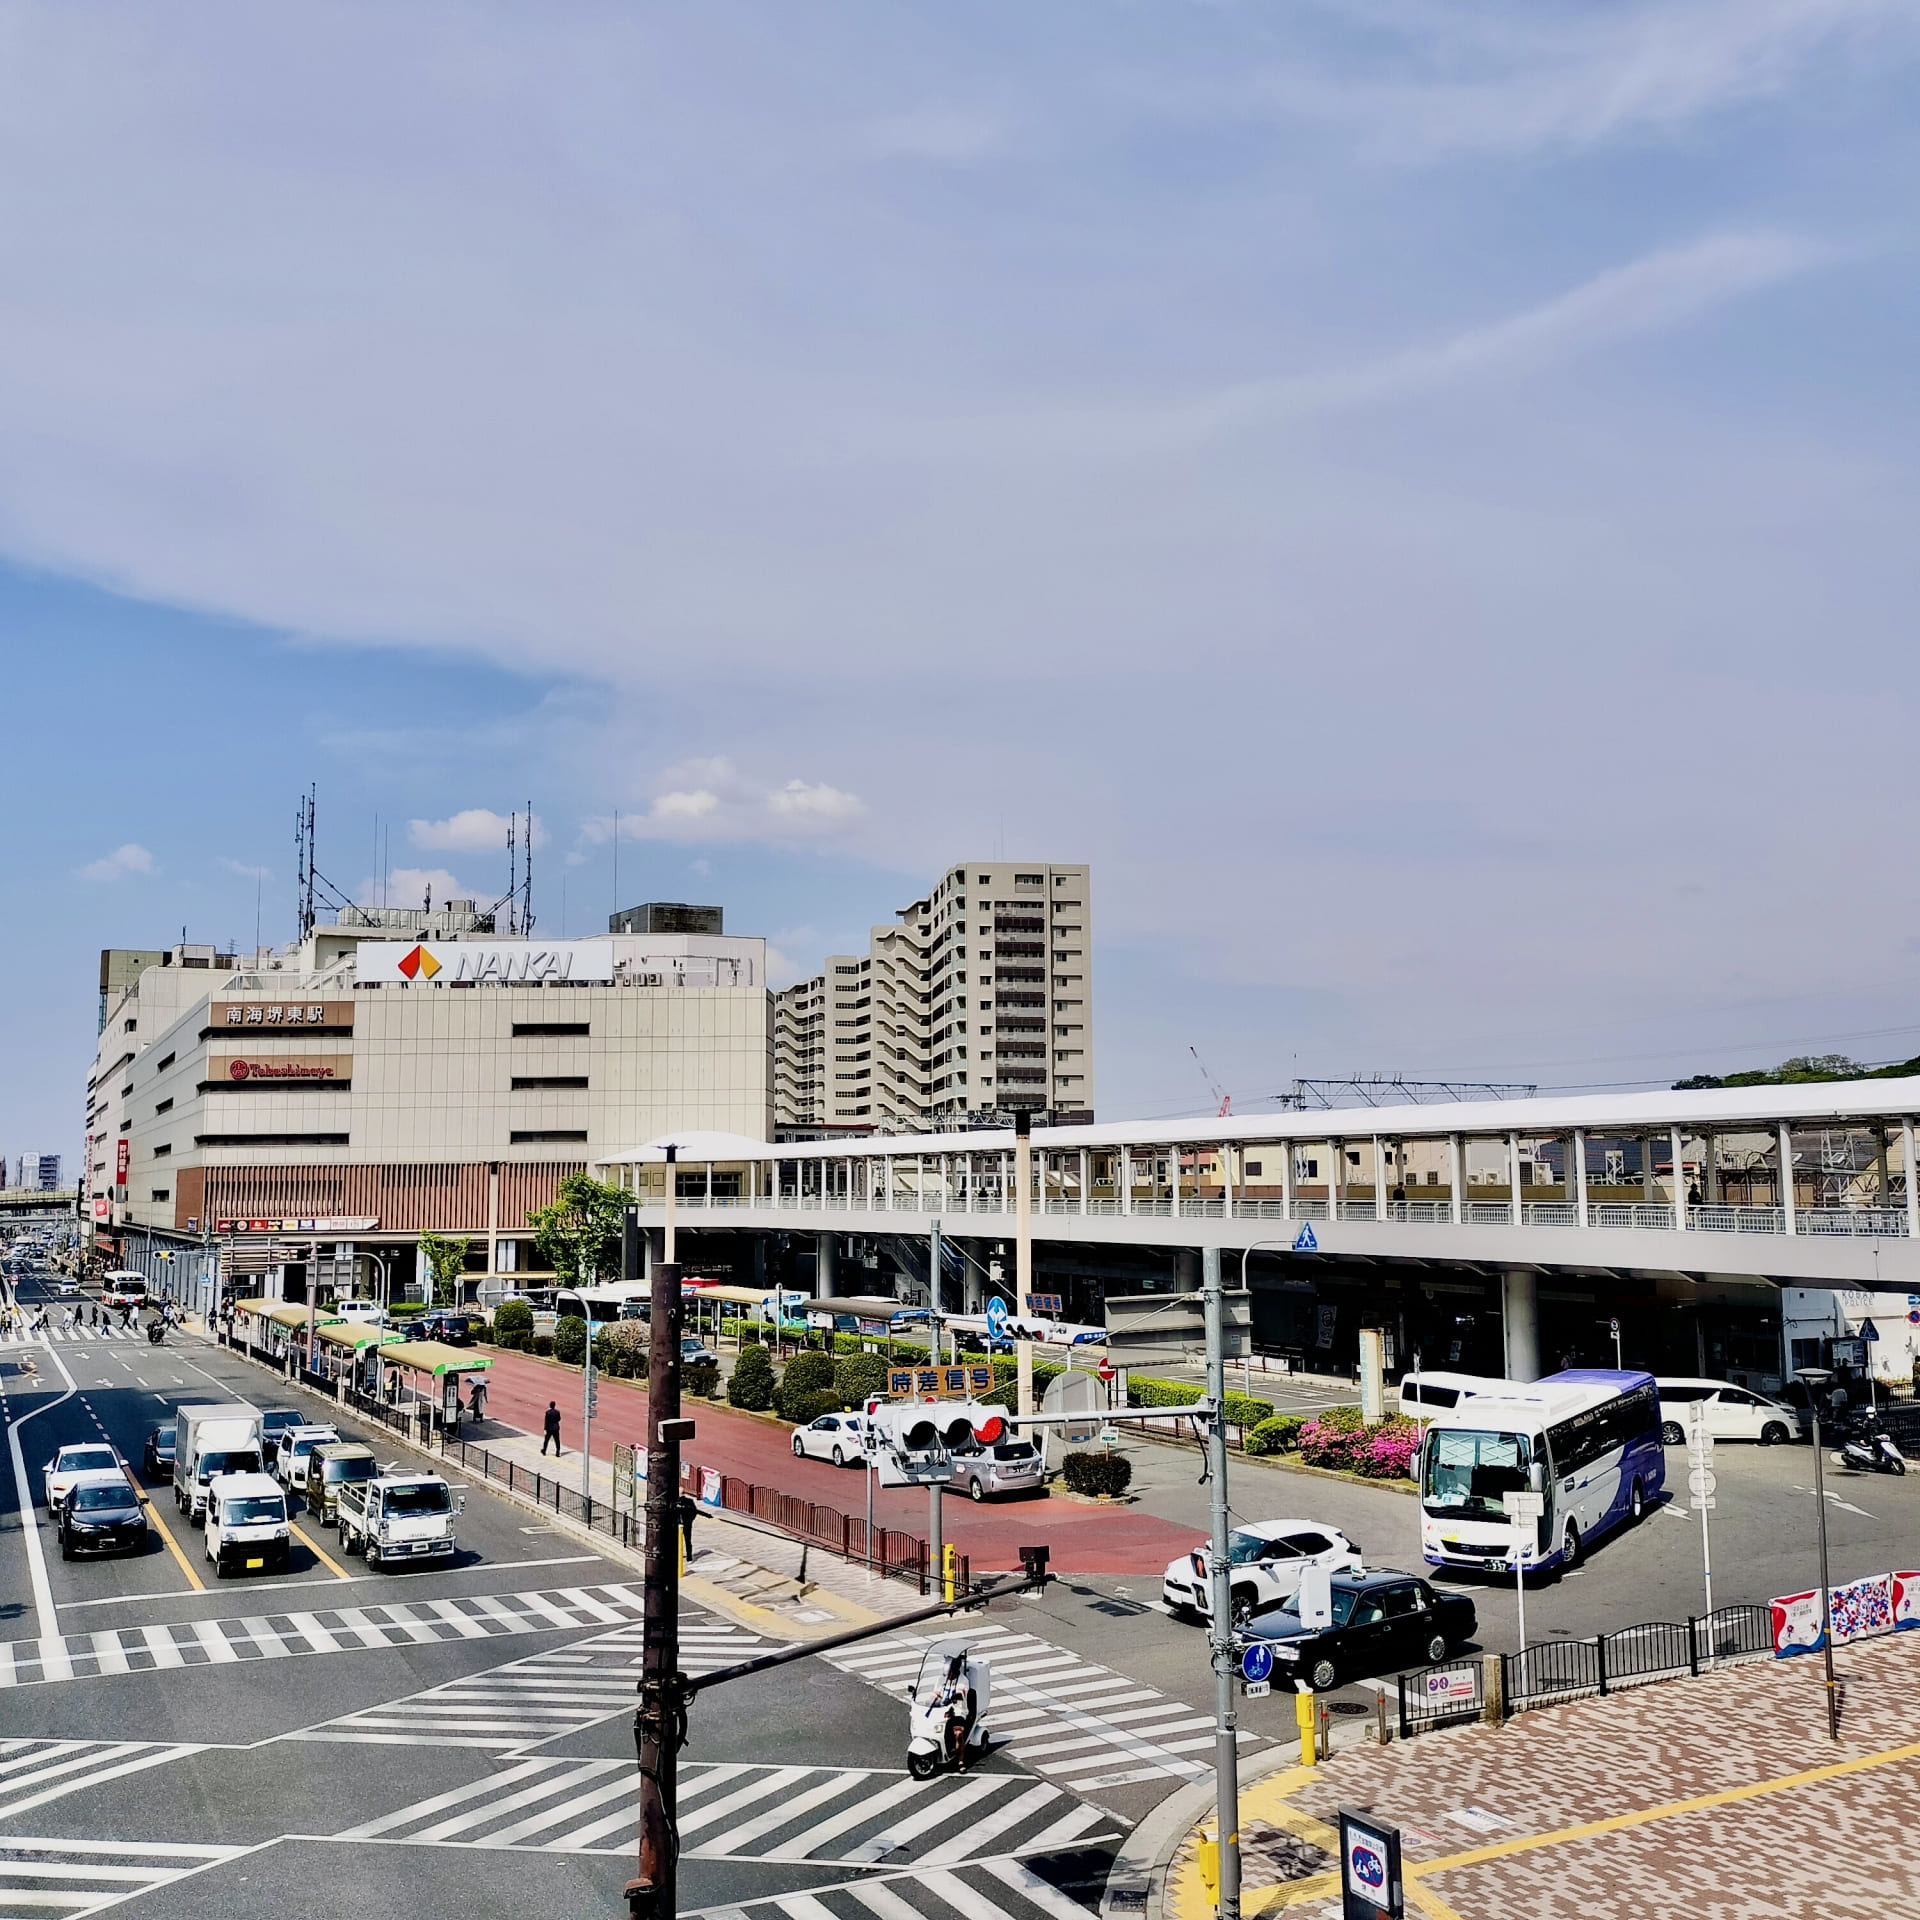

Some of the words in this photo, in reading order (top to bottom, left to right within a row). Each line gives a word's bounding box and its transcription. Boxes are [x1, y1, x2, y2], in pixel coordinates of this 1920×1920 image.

[455, 951, 574, 980] NANKAI
[226, 1005, 324, 1024] 南海堺東駅
[249, 1063, 334, 1079] Takashimaya
[891, 1368, 991, 1393] 時差信号
